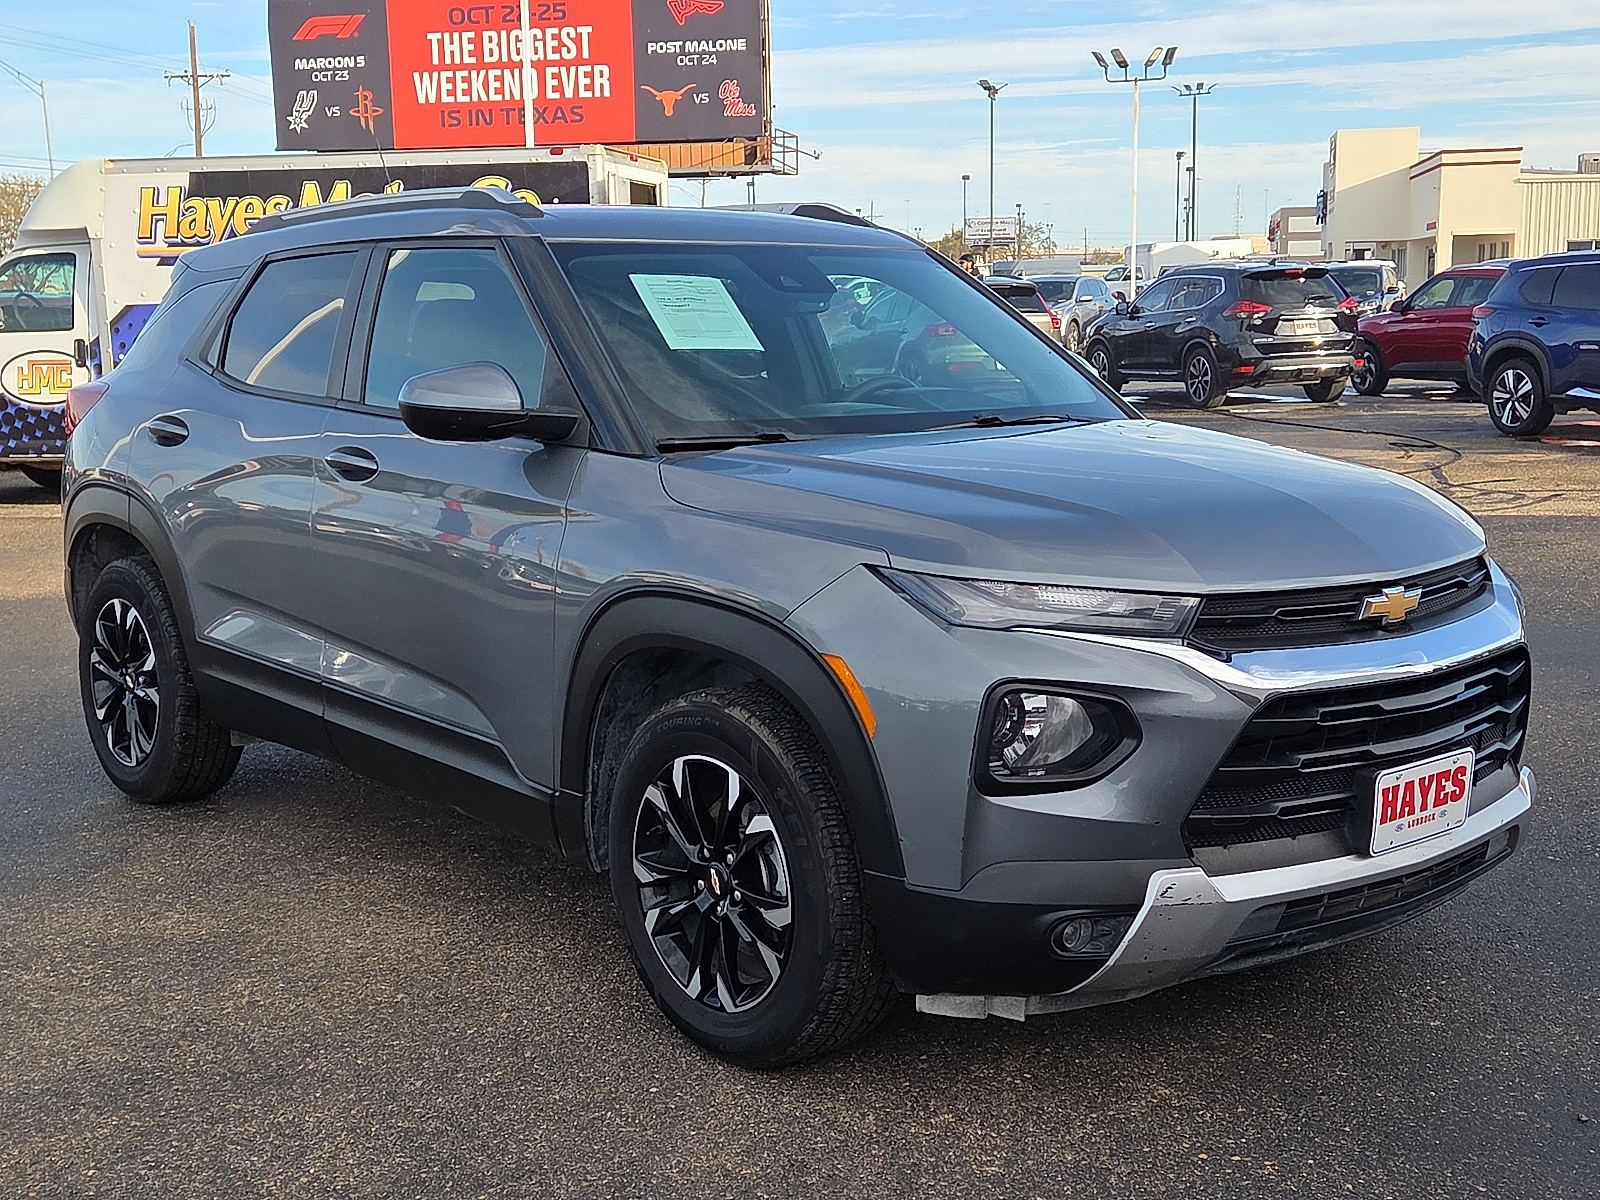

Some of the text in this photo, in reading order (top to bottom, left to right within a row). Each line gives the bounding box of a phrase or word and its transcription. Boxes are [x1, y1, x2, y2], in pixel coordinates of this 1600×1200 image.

[448, 5, 495, 25] OCT
[426, 25, 593, 66] THE BIGGEST
[647, 38, 747, 55] POST MALONE
[294, 55, 366, 71] MAROON 5
[677, 53, 718, 67] OCT 24
[311, 69, 350, 82] OCT 23
[545, 63, 611, 100] EVER
[719, 79, 740, 99] Ole
[693, 92, 710, 104] VS
[325, 106, 341, 117] VS
[723, 97, 757, 117] Miss
[439, 108, 462, 128] IS
[467, 107, 493, 127] IN
[1296, 322, 1317, 330] HAYES
[17, 359, 72, 394] HMC
[656, 716, 702, 733] TOURING
[1379, 765, 1468, 826] HAYES
[1407, 813, 1436, 828] LUBBOCK
